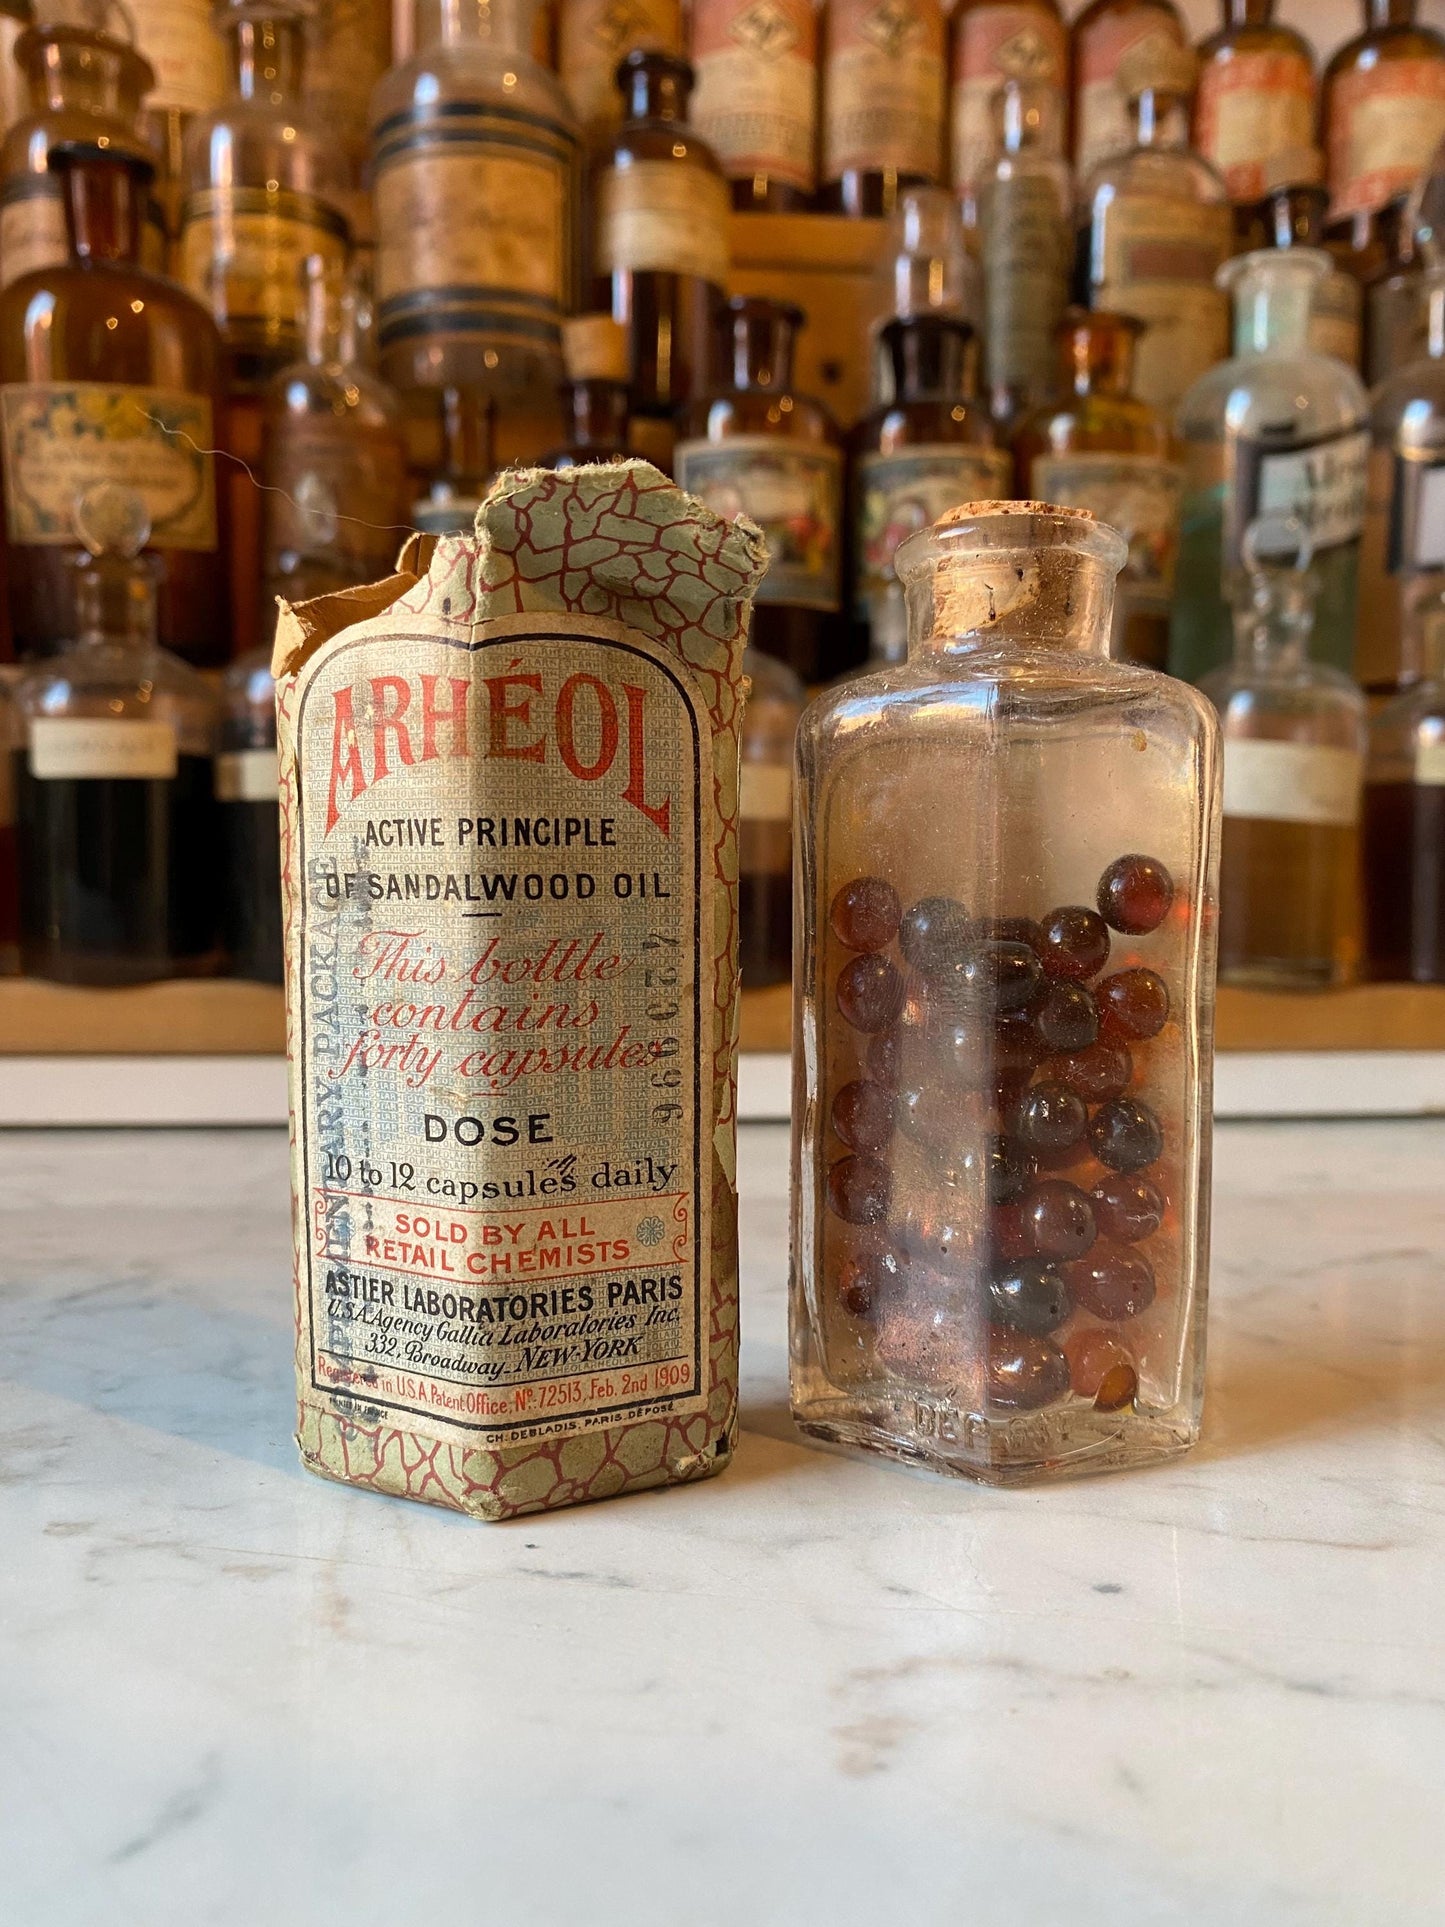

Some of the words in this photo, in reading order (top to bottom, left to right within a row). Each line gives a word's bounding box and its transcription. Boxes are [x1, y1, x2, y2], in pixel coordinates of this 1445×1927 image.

[323, 658, 672, 843] ARHÉOL
[365, 817, 445, 847] ACTIVE
[458, 817, 618, 847] PRINCIPLE
[326, 872, 356, 899] OF
[367, 873, 596, 902] SANDALWOOD
[613, 872, 671, 899] OIL
[307, 854, 341, 1061] PACKAGE
[352, 929, 447, 984] This
[455, 931, 637, 984] bottle
[370, 988, 601, 1033] contains
[327, 1029, 444, 1088] forty
[451, 1026, 664, 1089] capsules
[424, 1113, 554, 1147] DOSE
[327, 1153, 353, 1181] 10
[359, 1158, 383, 1186] to
[391, 1161, 416, 1190] 12
[426, 1169, 576, 1205] capsules
[591, 1157, 679, 1190] daily
[395, 1213, 468, 1245] SOLD
[483, 1223, 525, 1246] BY
[536, 1215, 595, 1239] ALL
[365, 1236, 453, 1272] RETAIL
[466, 1239, 630, 1275] CHEMISTS
[325, 1270, 394, 1307] ASTIER
[403, 1286, 594, 1324] LABORATORIES
[608, 1275, 684, 1309] PARIS
[436, 1323, 494, 1347] Gallia
[498, 1314, 637, 1346] Laboratories
[644, 1305, 682, 1327] Inc.
[514, 1335, 643, 1373] NEW-YORK
[382, 1377, 393, 1393] in
[589, 1377, 618, 1399] Feb.
[621, 1373, 648, 1394] 2nd
[654, 1363, 691, 1388] 1909
[584, 1414, 623, 1427] PARIS
